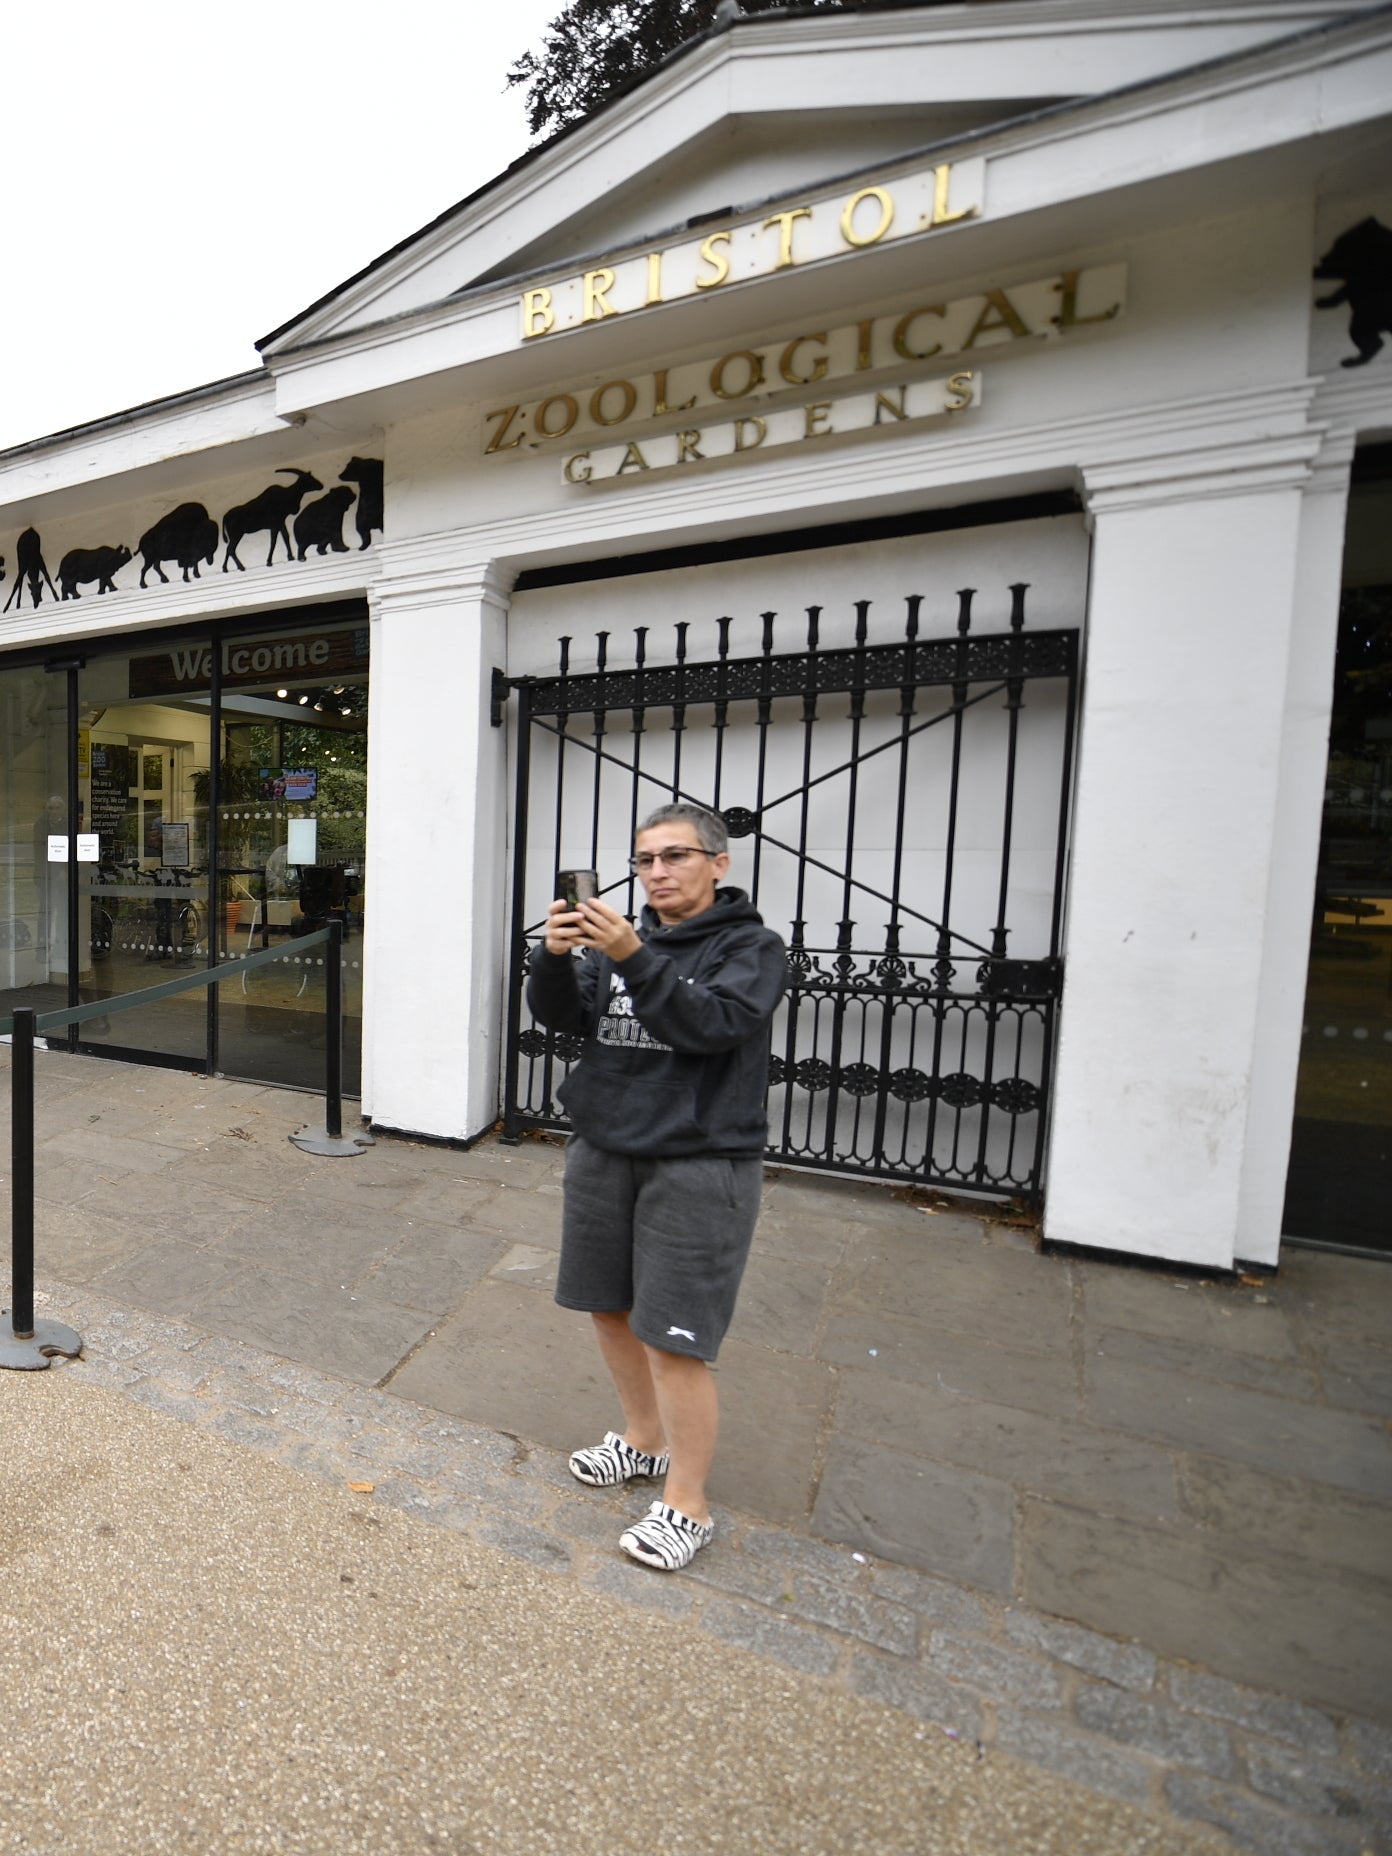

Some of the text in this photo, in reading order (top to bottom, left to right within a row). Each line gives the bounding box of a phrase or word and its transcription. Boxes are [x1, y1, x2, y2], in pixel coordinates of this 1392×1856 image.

[522, 163, 980, 341] BRISTOL
[484, 269, 1120, 455] ZOOLOGICAL
[564, 371, 976, 485] GARDENS
[170, 639, 329, 681] Welcome
